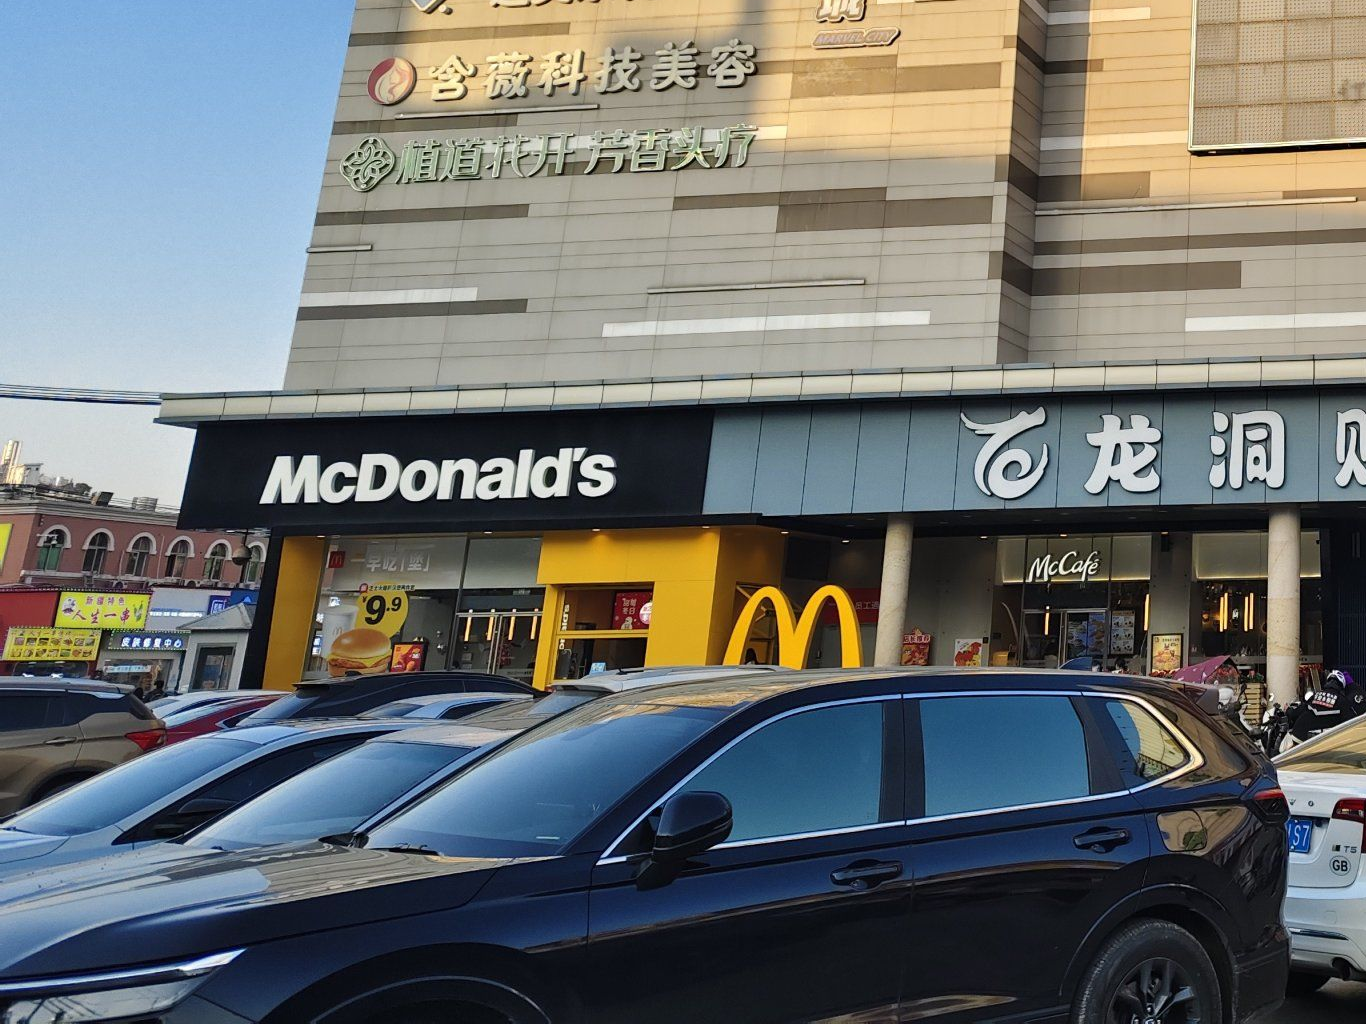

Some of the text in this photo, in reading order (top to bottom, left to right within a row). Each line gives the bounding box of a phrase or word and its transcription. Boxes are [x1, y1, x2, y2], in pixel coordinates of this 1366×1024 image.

[428, 39, 758, 101] 含薇科技美容
[260, 446, 618, 506] McDonald's
[1026, 550, 1100, 583] McCafé
[73, 608, 130, 624] 人生一串
[1332, 859, 1348, 873] GB
